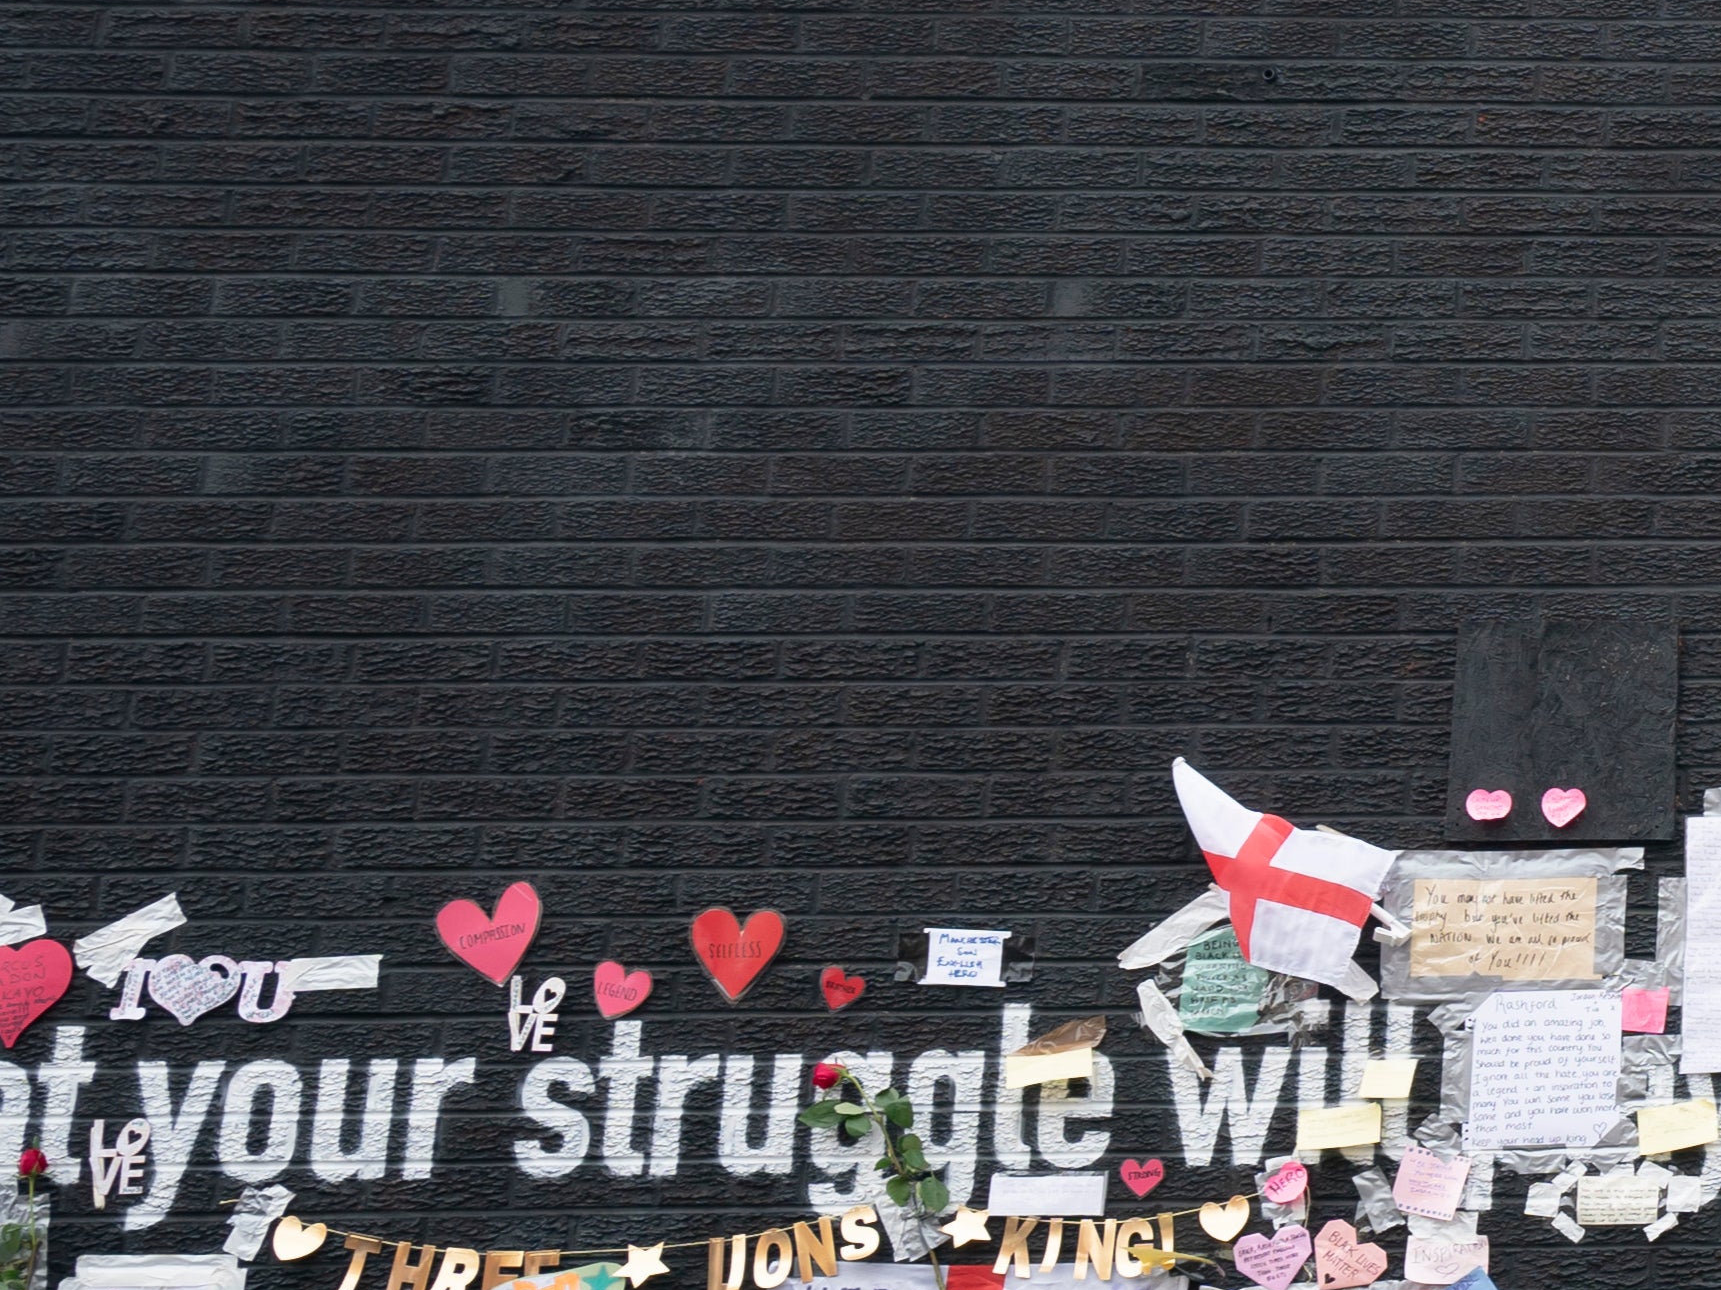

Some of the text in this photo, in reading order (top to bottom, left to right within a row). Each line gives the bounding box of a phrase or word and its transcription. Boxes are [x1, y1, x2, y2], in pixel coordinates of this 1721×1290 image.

[459, 922, 525, 949] COMPASSION
[708, 941, 763, 958] SELFLESS
[123, 1057, 475, 1231] your
[514, 1002, 1116, 1217] struggle
[1268, 1168, 1305, 1195] HERO
[992, 1212, 1174, 1280] KING!
[1328, 1230, 1382, 1276] BLACK LIVES
[1323, 1251, 1360, 1279] MATTER
